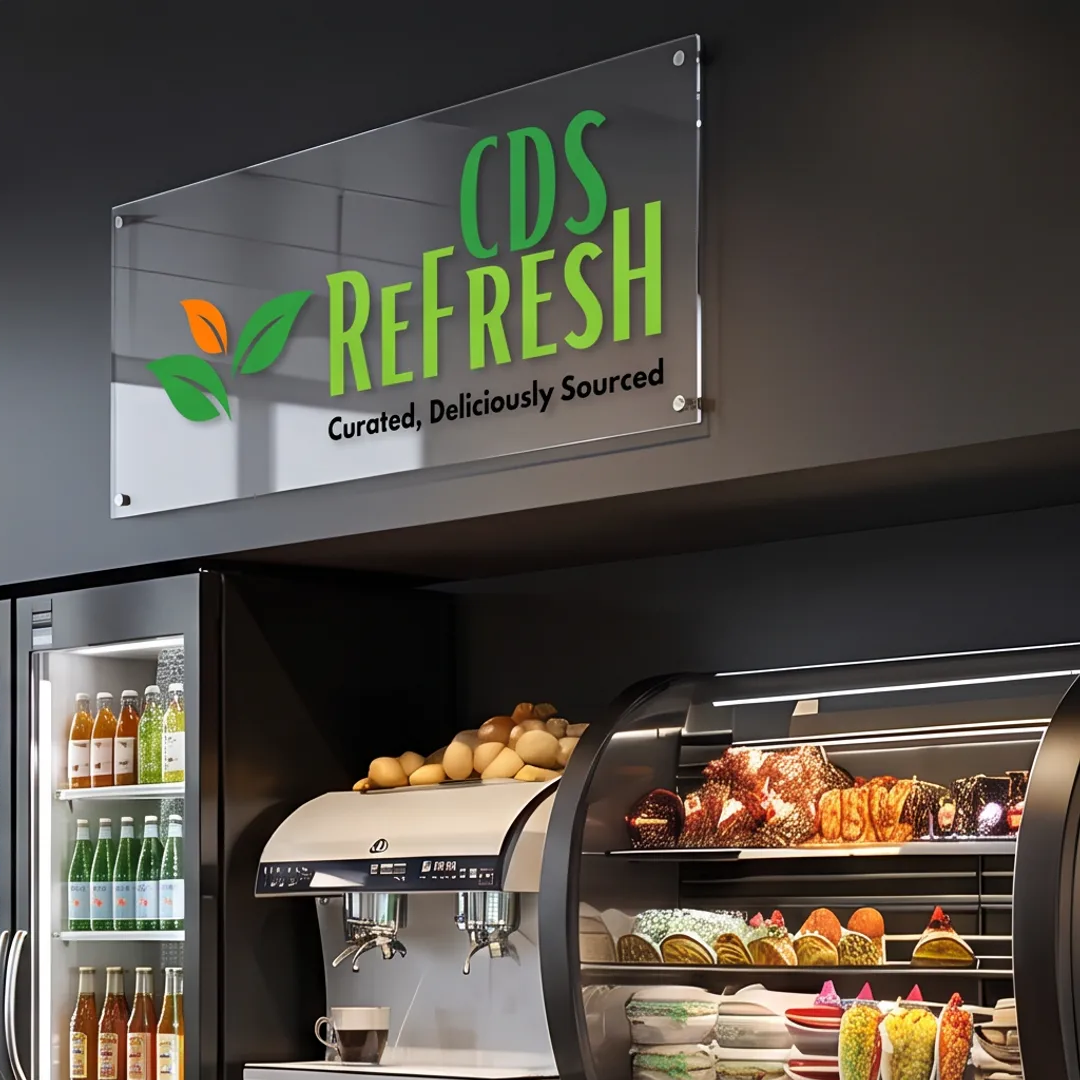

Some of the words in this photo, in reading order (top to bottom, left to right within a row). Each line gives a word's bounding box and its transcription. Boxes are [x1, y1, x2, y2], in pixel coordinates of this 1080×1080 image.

[460, 109, 607, 258] CDS
[328, 402, 422, 441] Curated,
[429, 380, 554, 424] Deliciously
[561, 358, 664, 401] Sourced
